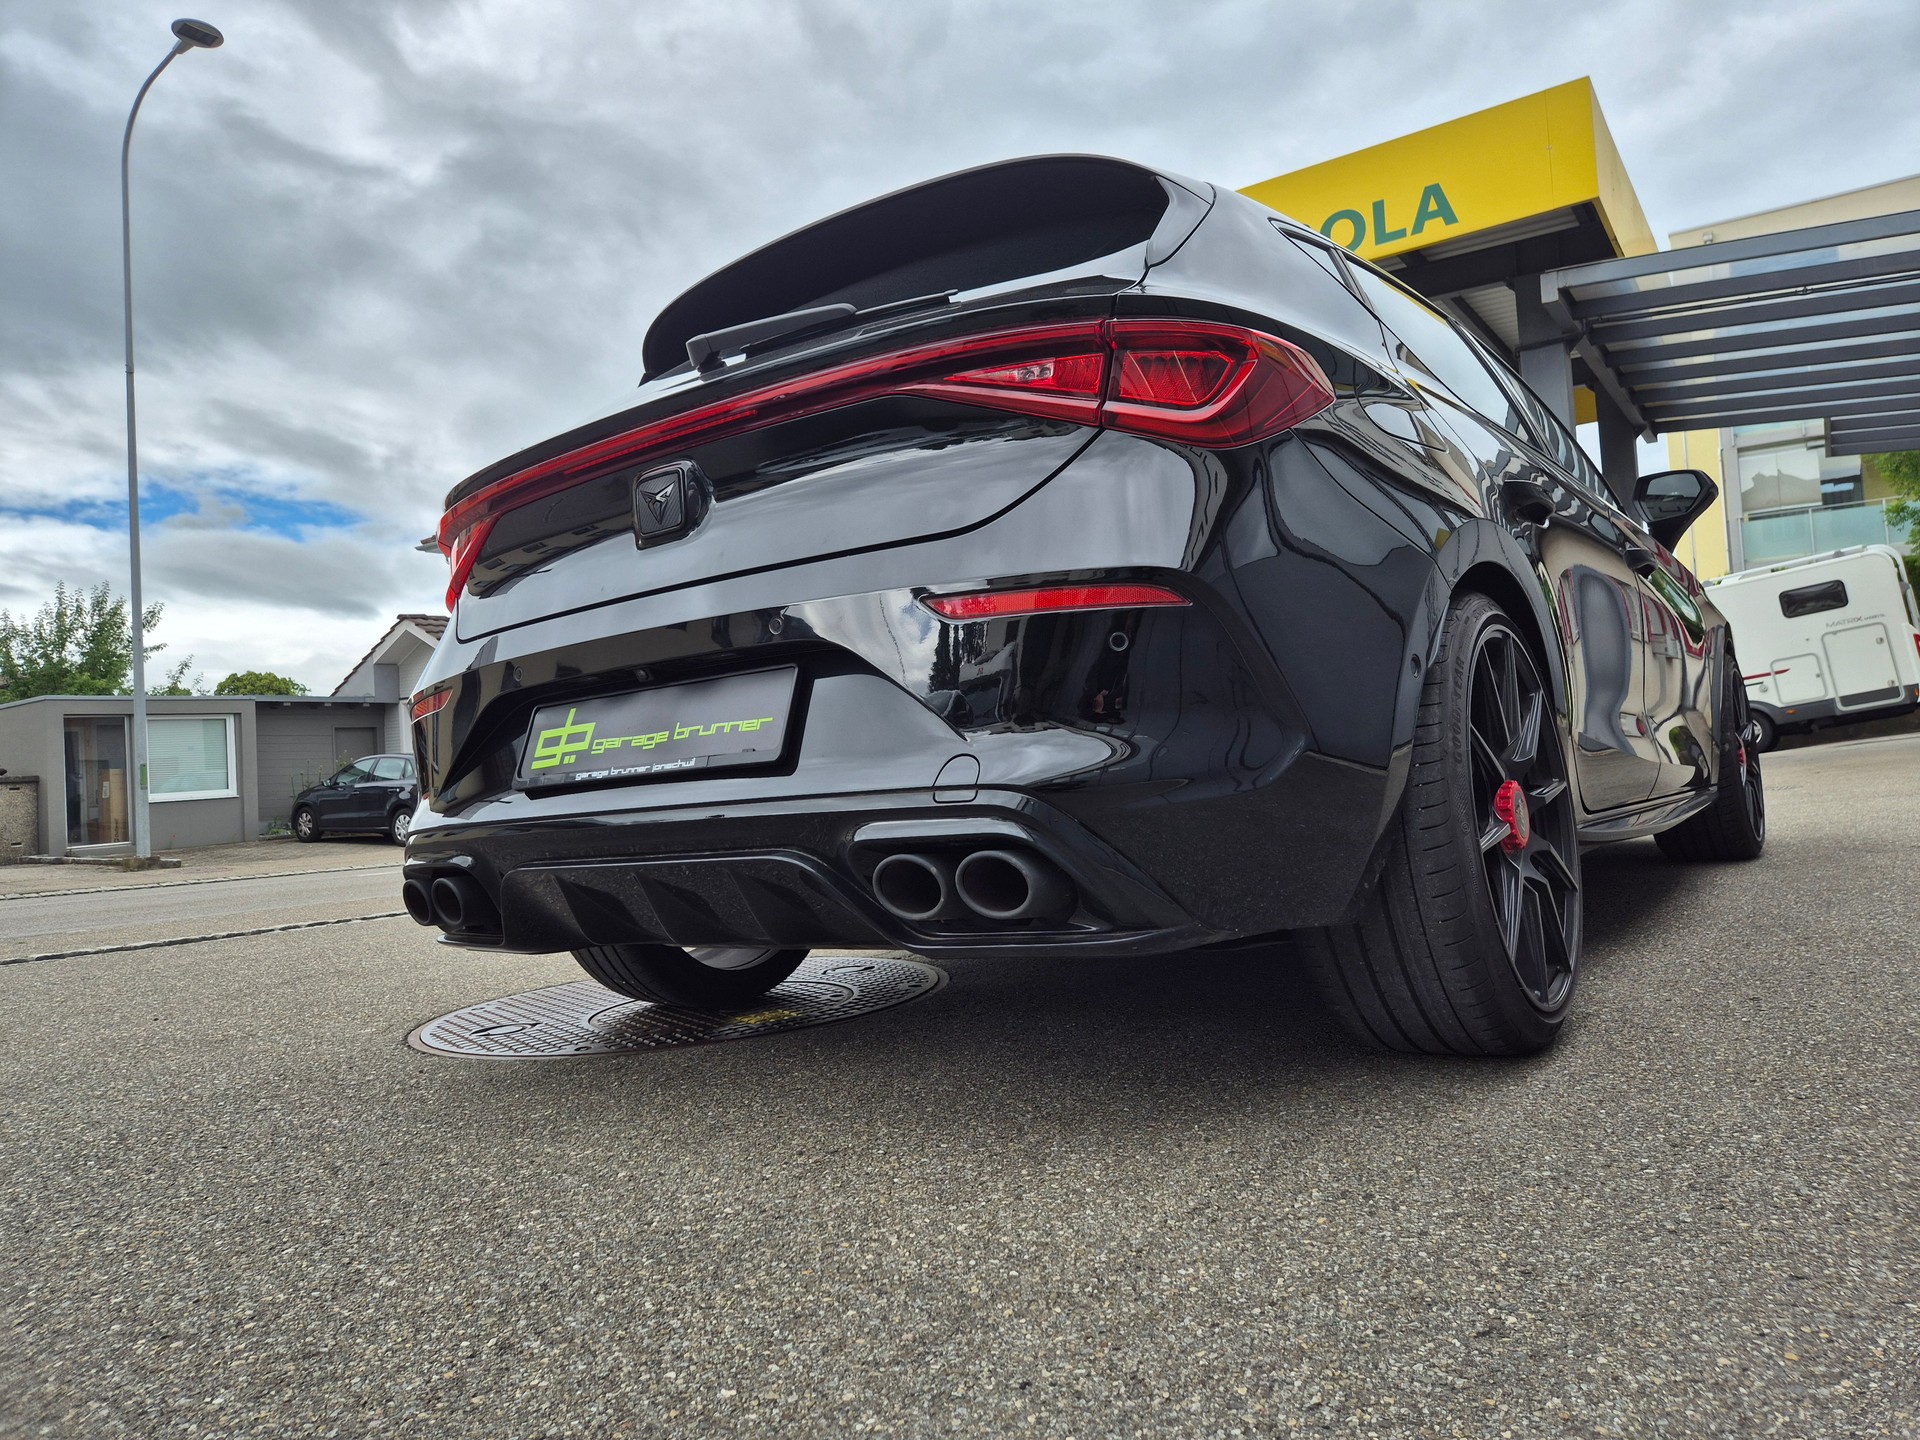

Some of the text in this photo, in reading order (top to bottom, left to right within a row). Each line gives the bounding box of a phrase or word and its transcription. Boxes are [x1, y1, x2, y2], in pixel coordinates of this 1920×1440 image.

[1304, 182, 1459, 252] OLA
[591, 717, 774, 755] garage brunner
[575, 757, 696, 781] garage brunner jonschwil
